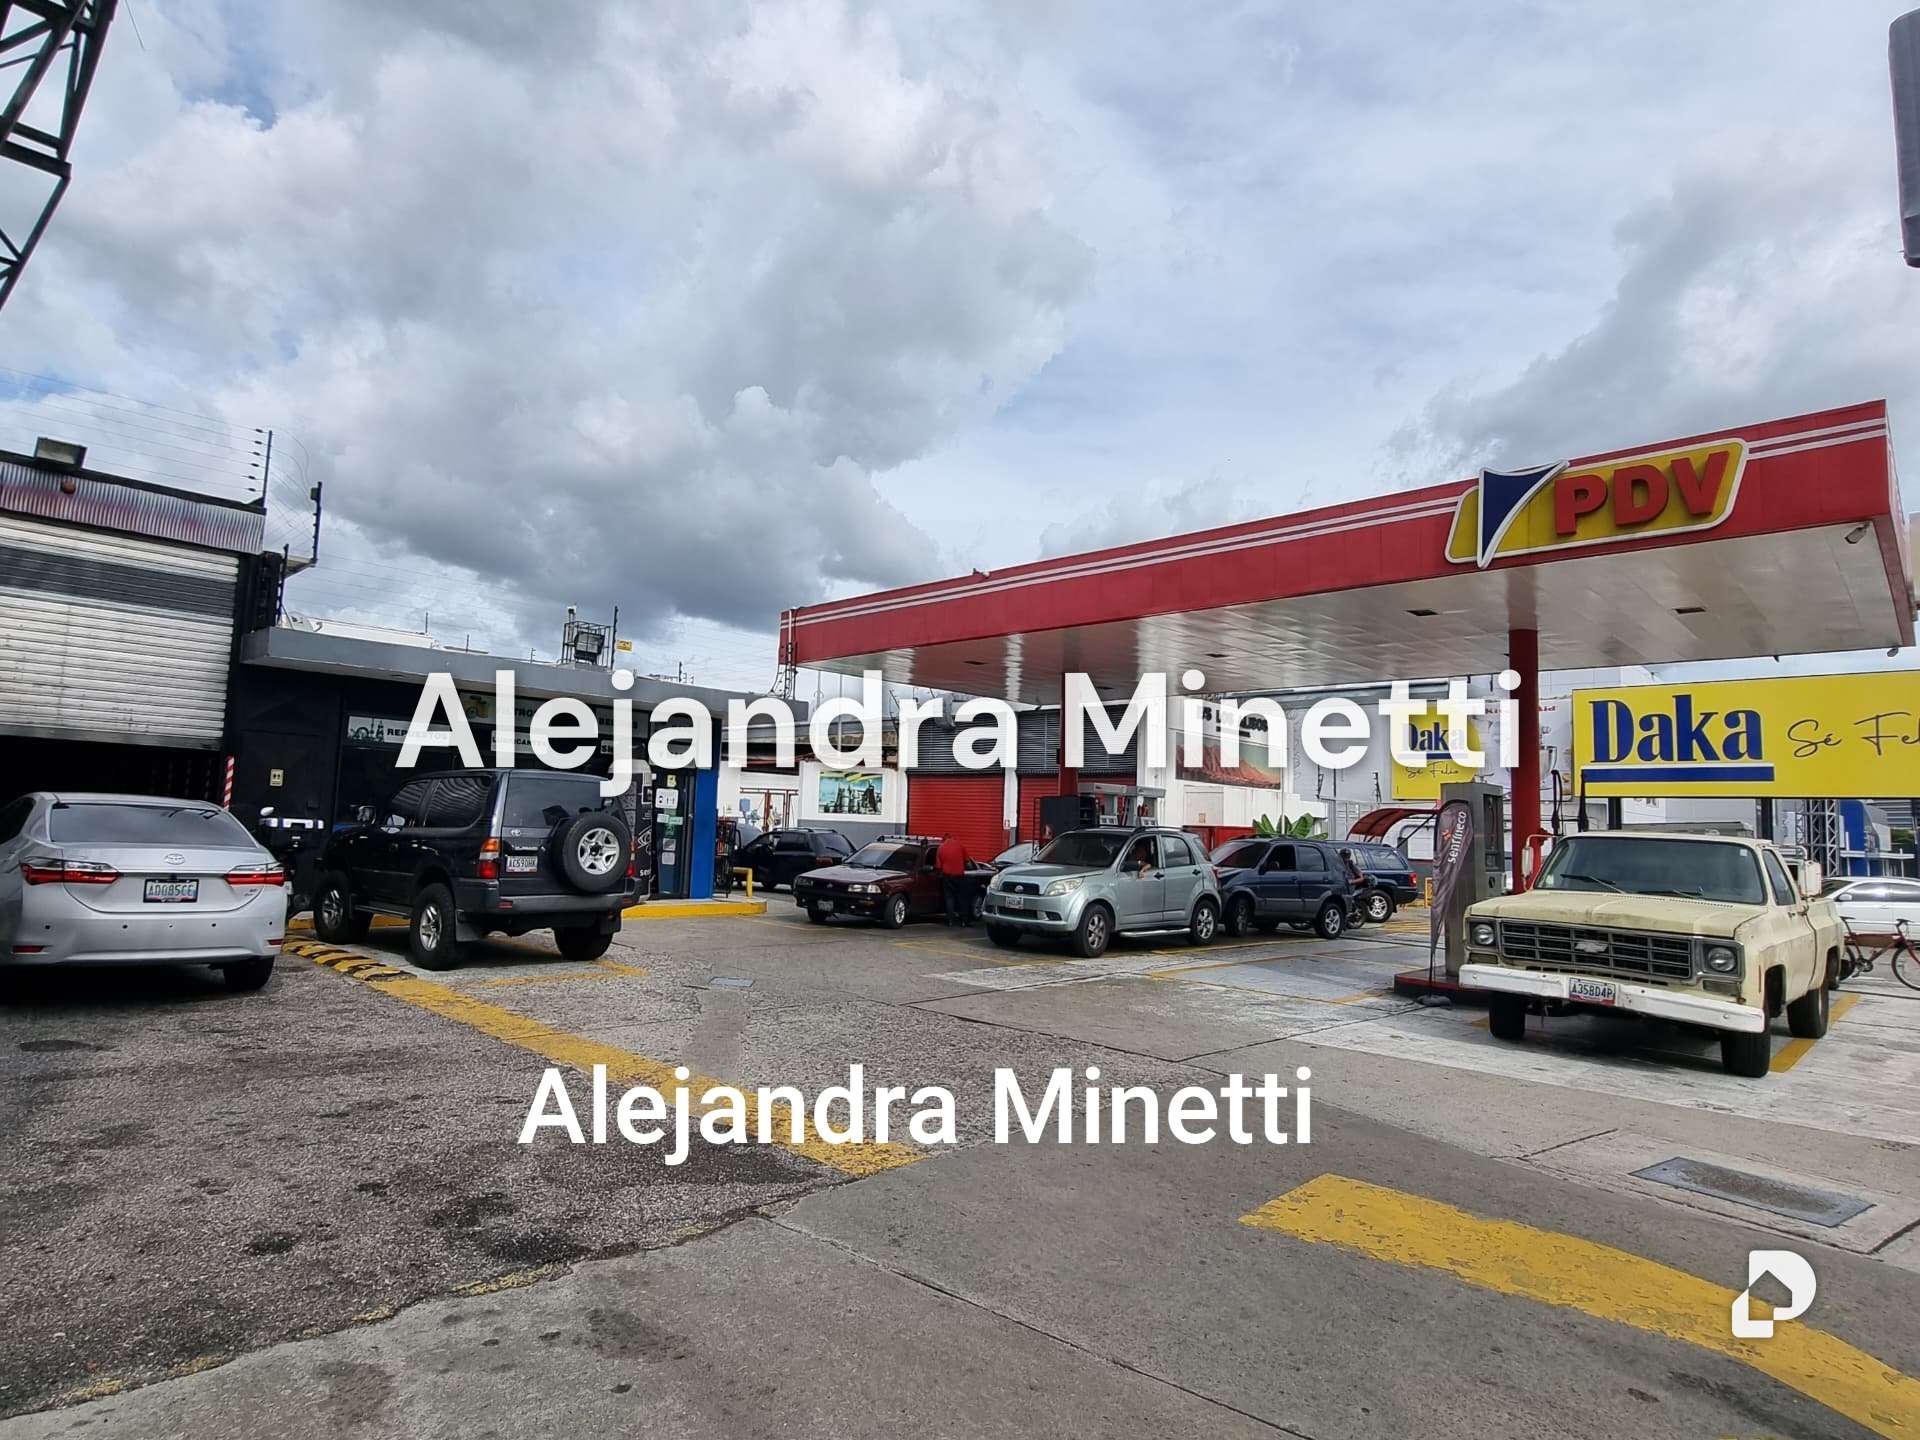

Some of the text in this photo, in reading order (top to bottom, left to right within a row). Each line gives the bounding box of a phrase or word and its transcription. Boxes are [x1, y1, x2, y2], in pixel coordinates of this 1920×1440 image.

[1555, 450, 1730, 537] PDV
[1400, 722, 1465, 751] Daka
[1589, 694, 1764, 763] Daka
[1787, 719, 1842, 757] Sé
